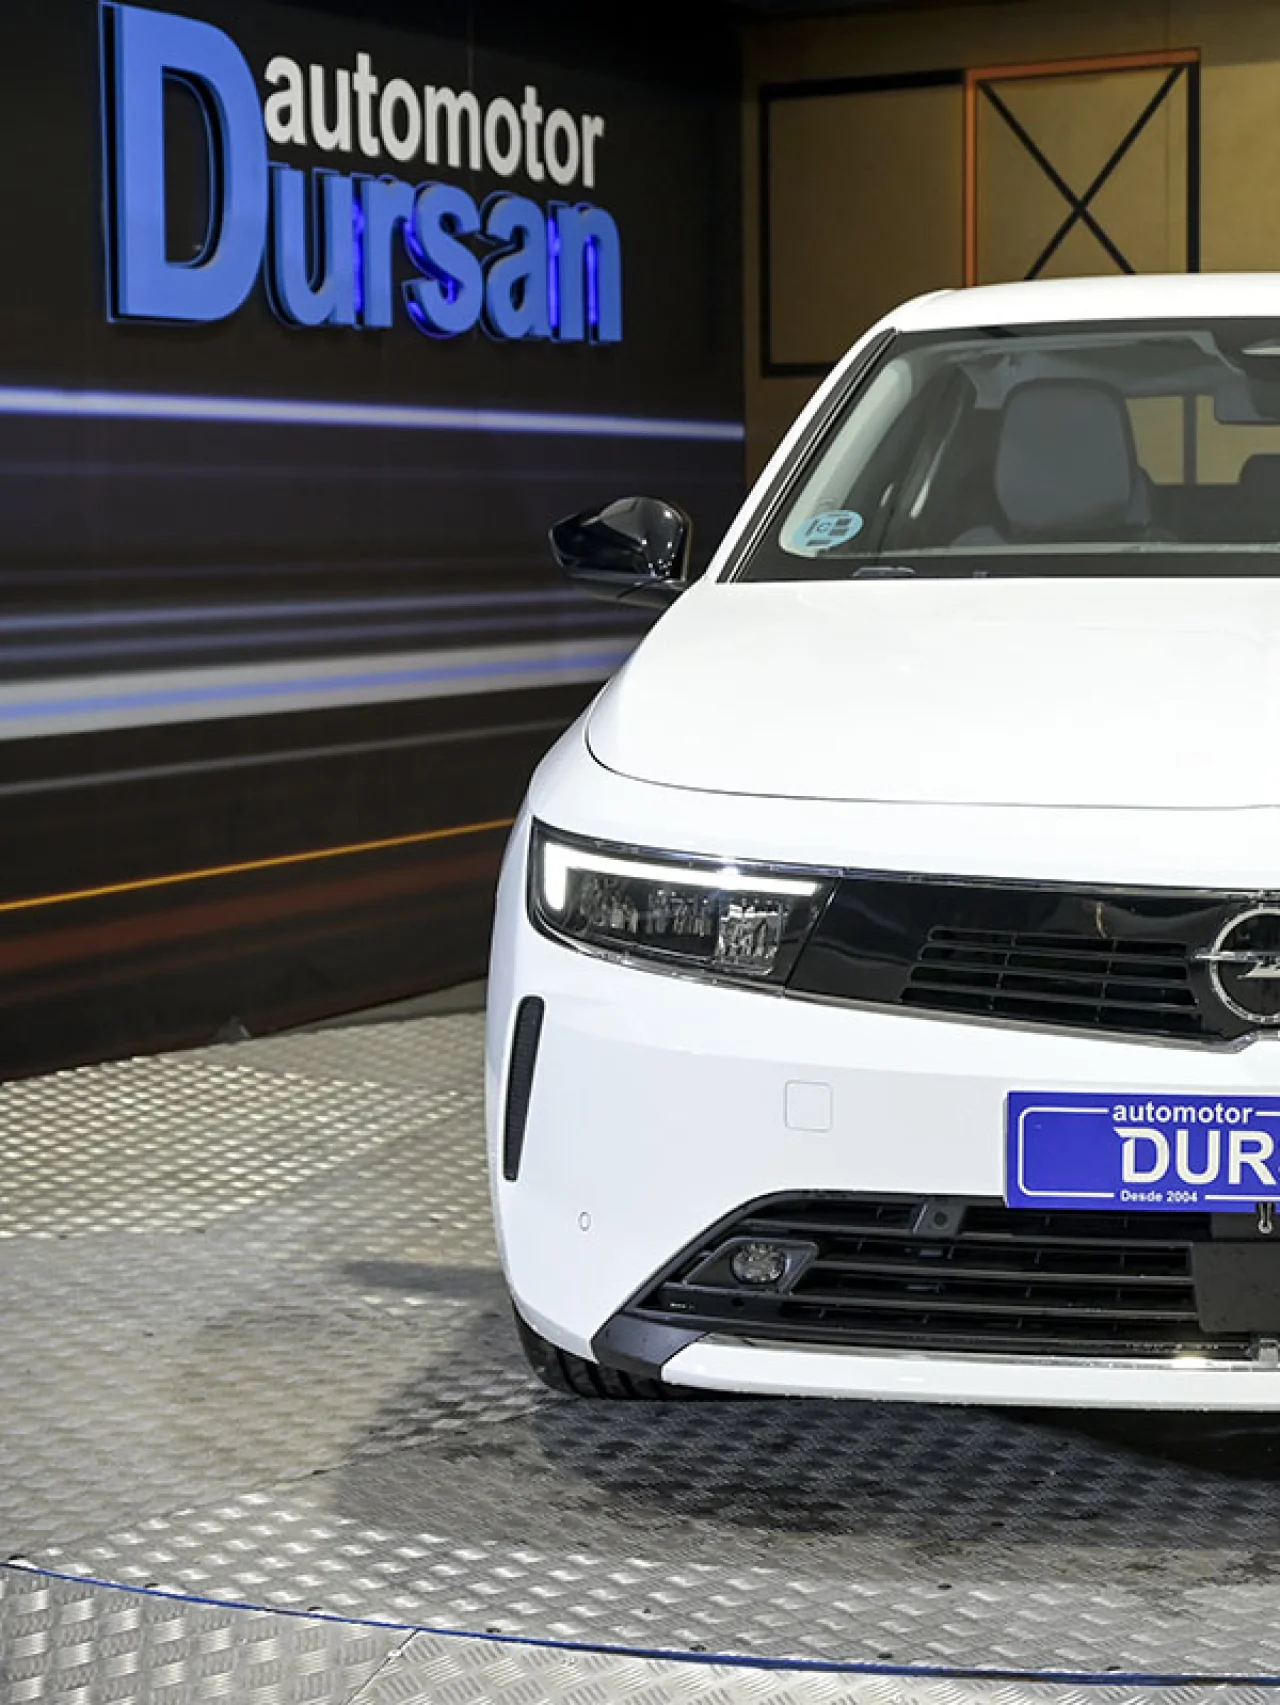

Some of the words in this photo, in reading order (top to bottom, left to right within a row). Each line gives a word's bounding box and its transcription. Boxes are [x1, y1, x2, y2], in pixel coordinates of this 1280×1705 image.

[263, 52, 606, 189] automotor
[103, 2, 623, 344] Dursan
[1112, 1101, 1254, 1125] automotor
[1120, 1189, 1163, 1203] Desde
[1166, 1190, 1198, 1204] 2004
